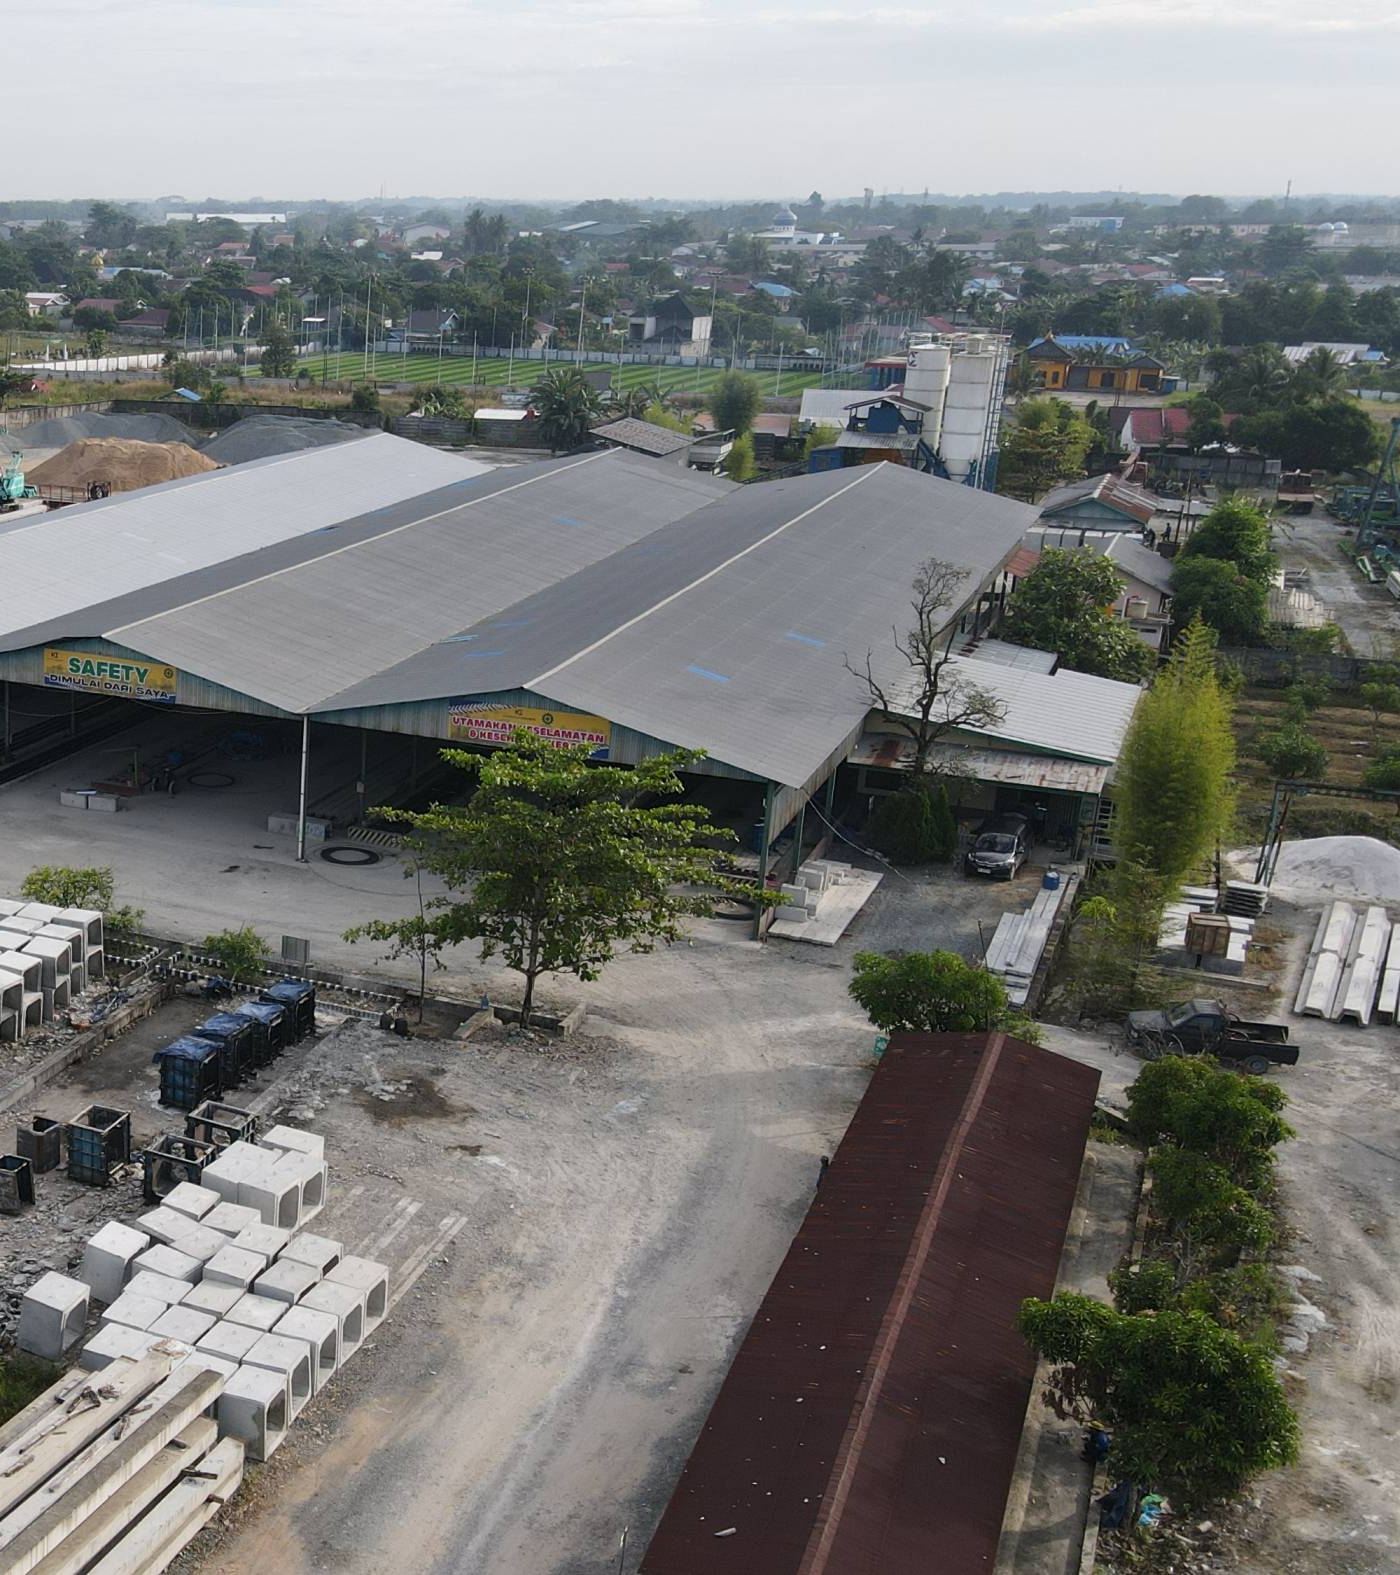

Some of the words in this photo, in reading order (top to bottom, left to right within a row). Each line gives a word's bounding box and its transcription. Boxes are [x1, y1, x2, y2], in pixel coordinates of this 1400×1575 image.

[68, 656, 149, 684] SAFETY
[50, 674, 100, 688] DIMULAI
[104, 682, 133, 694] DARI
[136, 687, 169, 699] SAYA
[452, 716, 517, 731] UTAMAKAN
[519, 724, 604, 743] SELAMATAN
[468, 729, 477, 739] &
